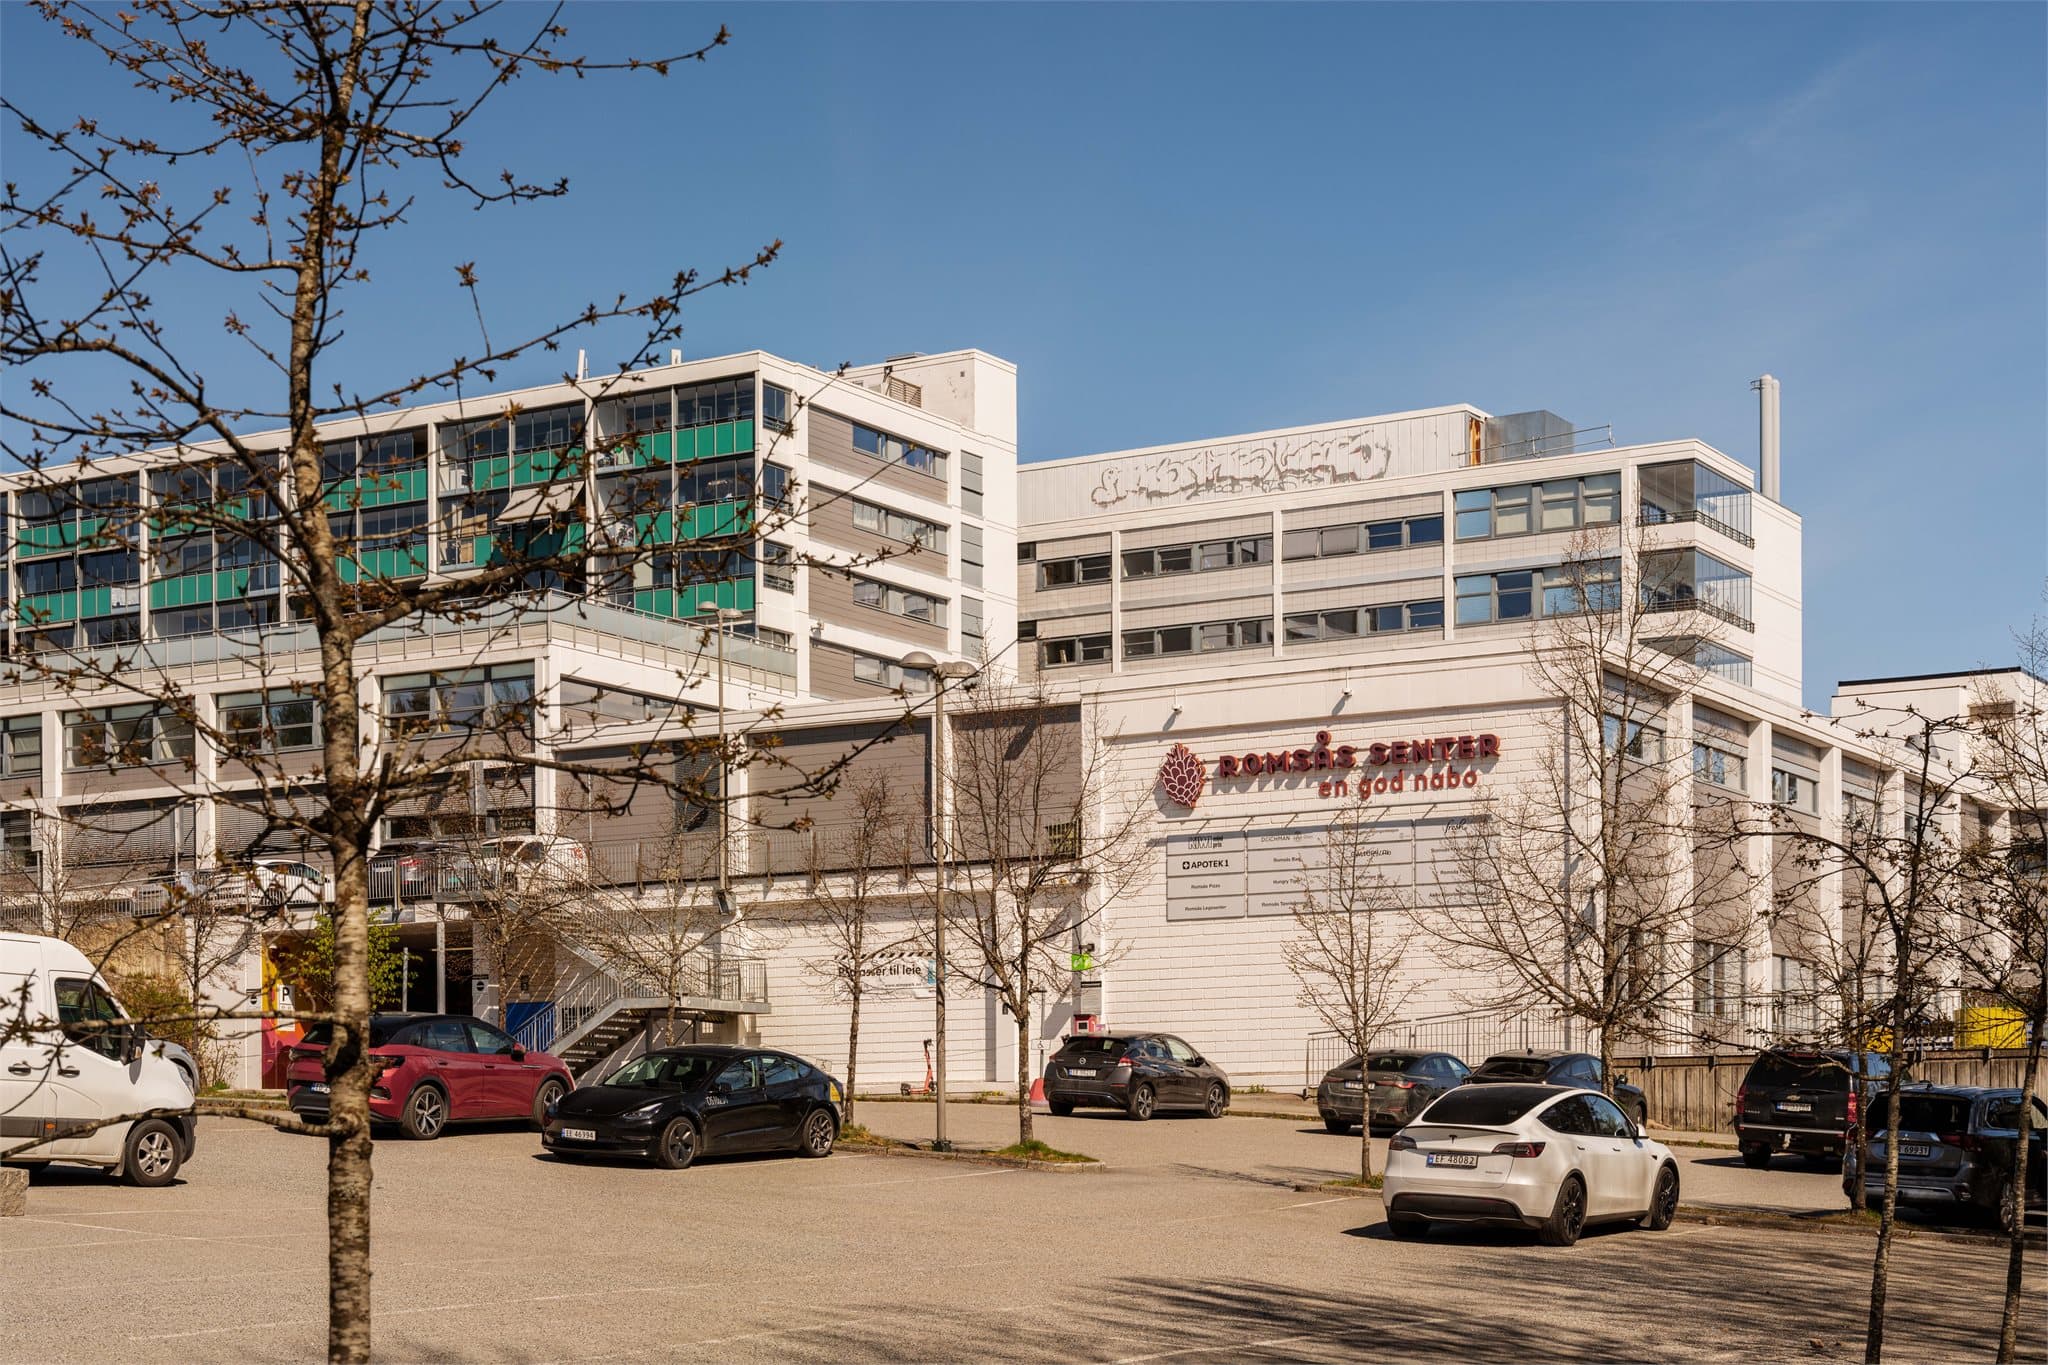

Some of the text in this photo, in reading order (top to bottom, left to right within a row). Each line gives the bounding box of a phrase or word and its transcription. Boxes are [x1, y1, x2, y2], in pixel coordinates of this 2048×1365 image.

[1219, 730, 1500, 777] ROMSÅS SENTER
[1318, 765, 1478, 800] en god nabo
[1191, 860, 1223, 869] APOTEK
[889, 964, 899, 975] til
[902, 964, 922, 975] leie
[282, 987, 290, 1002] P
[1447, 1154, 1474, 1164] 48082
